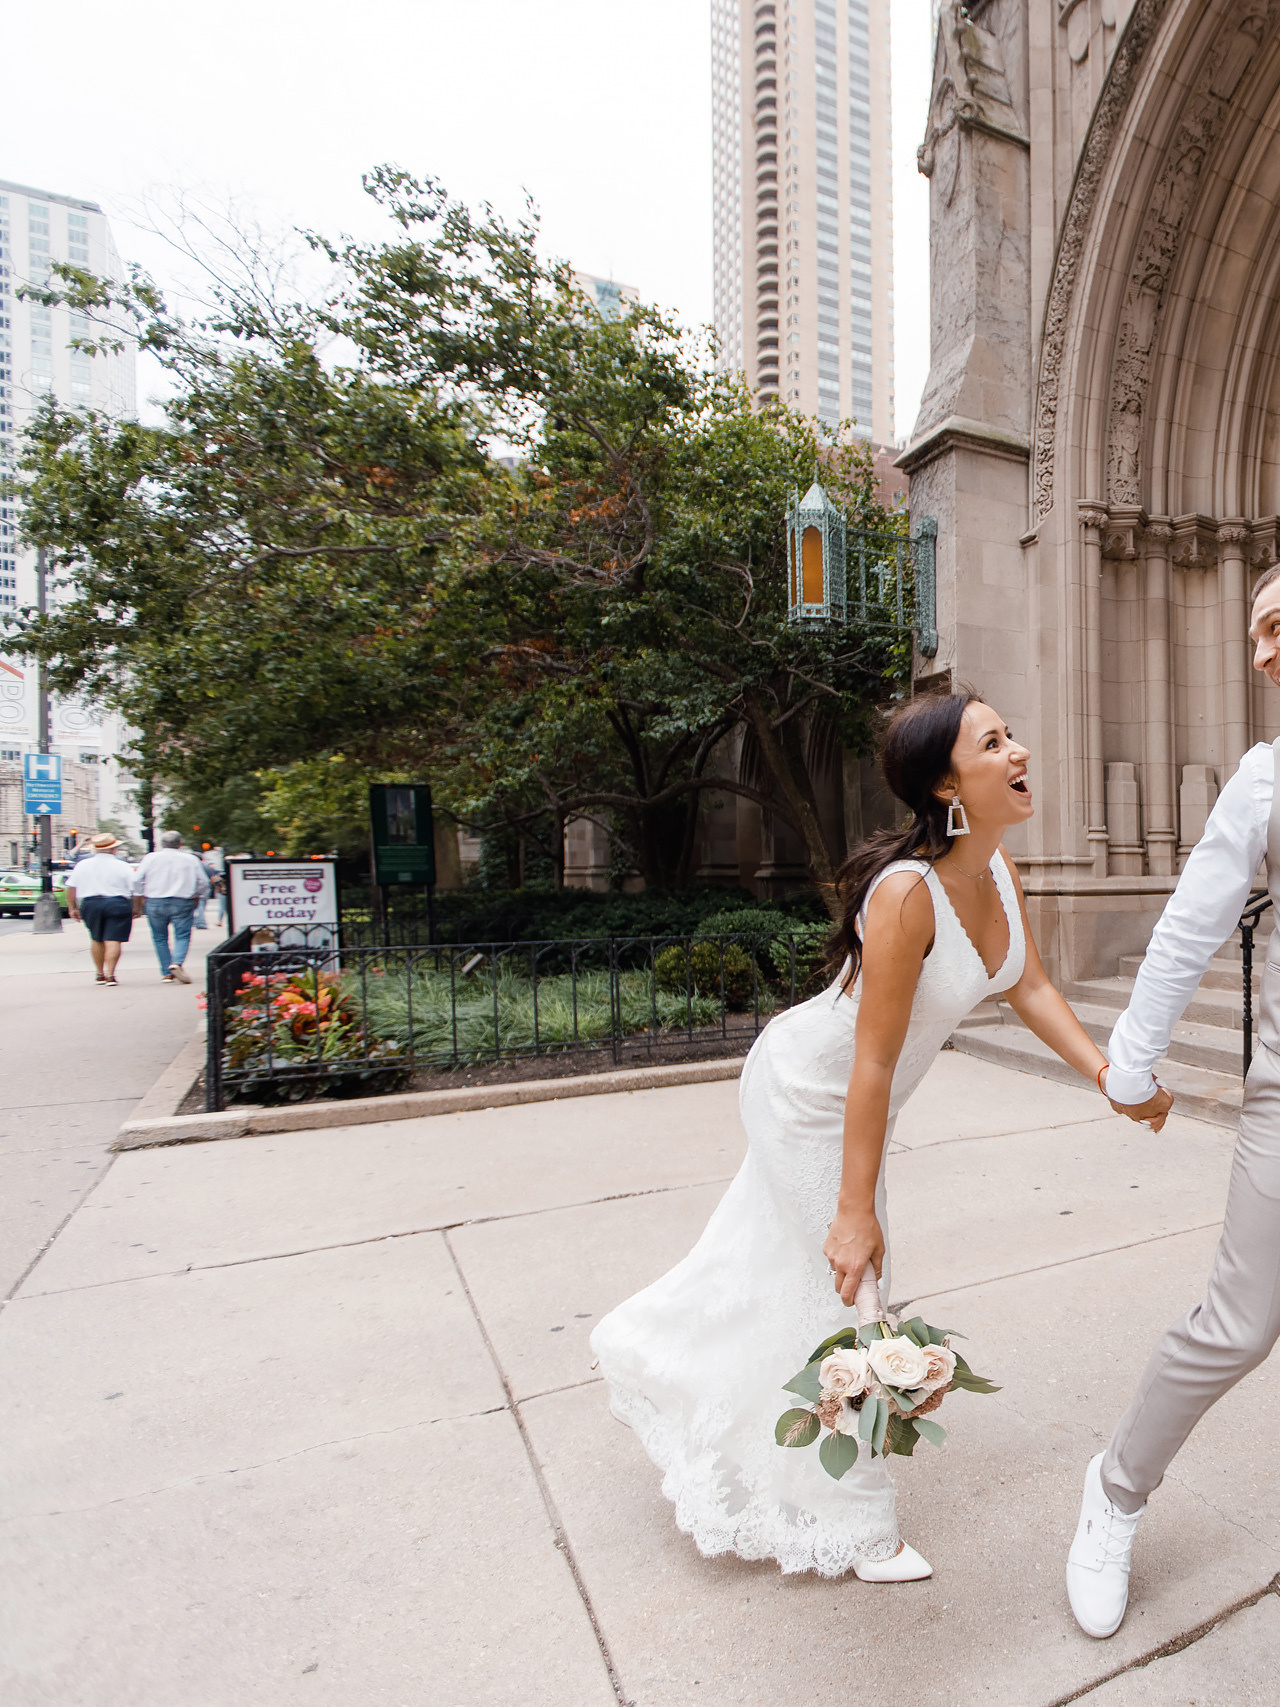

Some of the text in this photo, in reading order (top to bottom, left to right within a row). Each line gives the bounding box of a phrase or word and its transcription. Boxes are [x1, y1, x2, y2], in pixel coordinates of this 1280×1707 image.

[29, 755, 57, 780] H
[259, 884, 297, 894] Free
[248, 894, 318, 906] Concert
[266, 907, 317, 921] today
